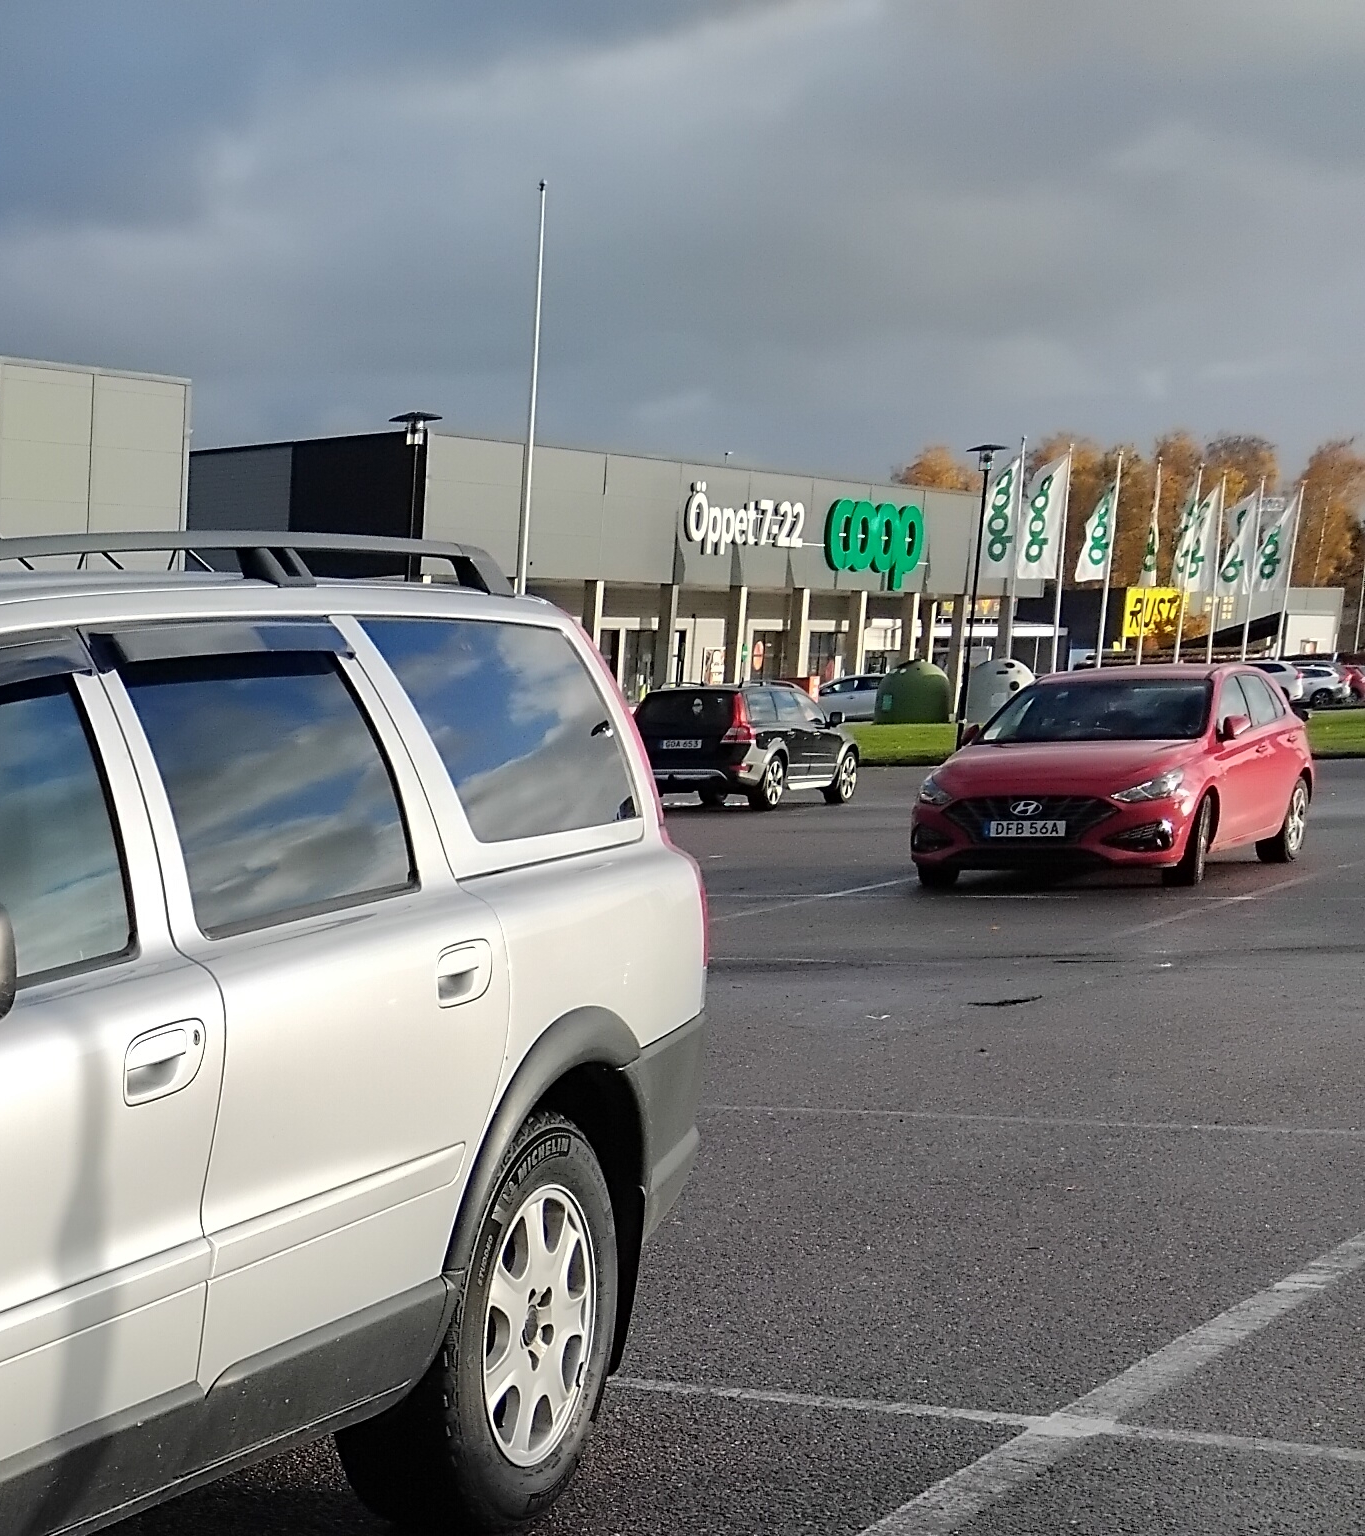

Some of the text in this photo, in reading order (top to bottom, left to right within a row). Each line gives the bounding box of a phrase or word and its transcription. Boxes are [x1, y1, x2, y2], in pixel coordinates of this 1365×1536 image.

[690, 480, 805, 555] Öppet 7-22
[827, 498, 924, 589] coop
[682, 740, 699, 748] 653
[995, 821, 1059, 836] DFB 56A
[517, 1136, 570, 1184] MICHELIN
